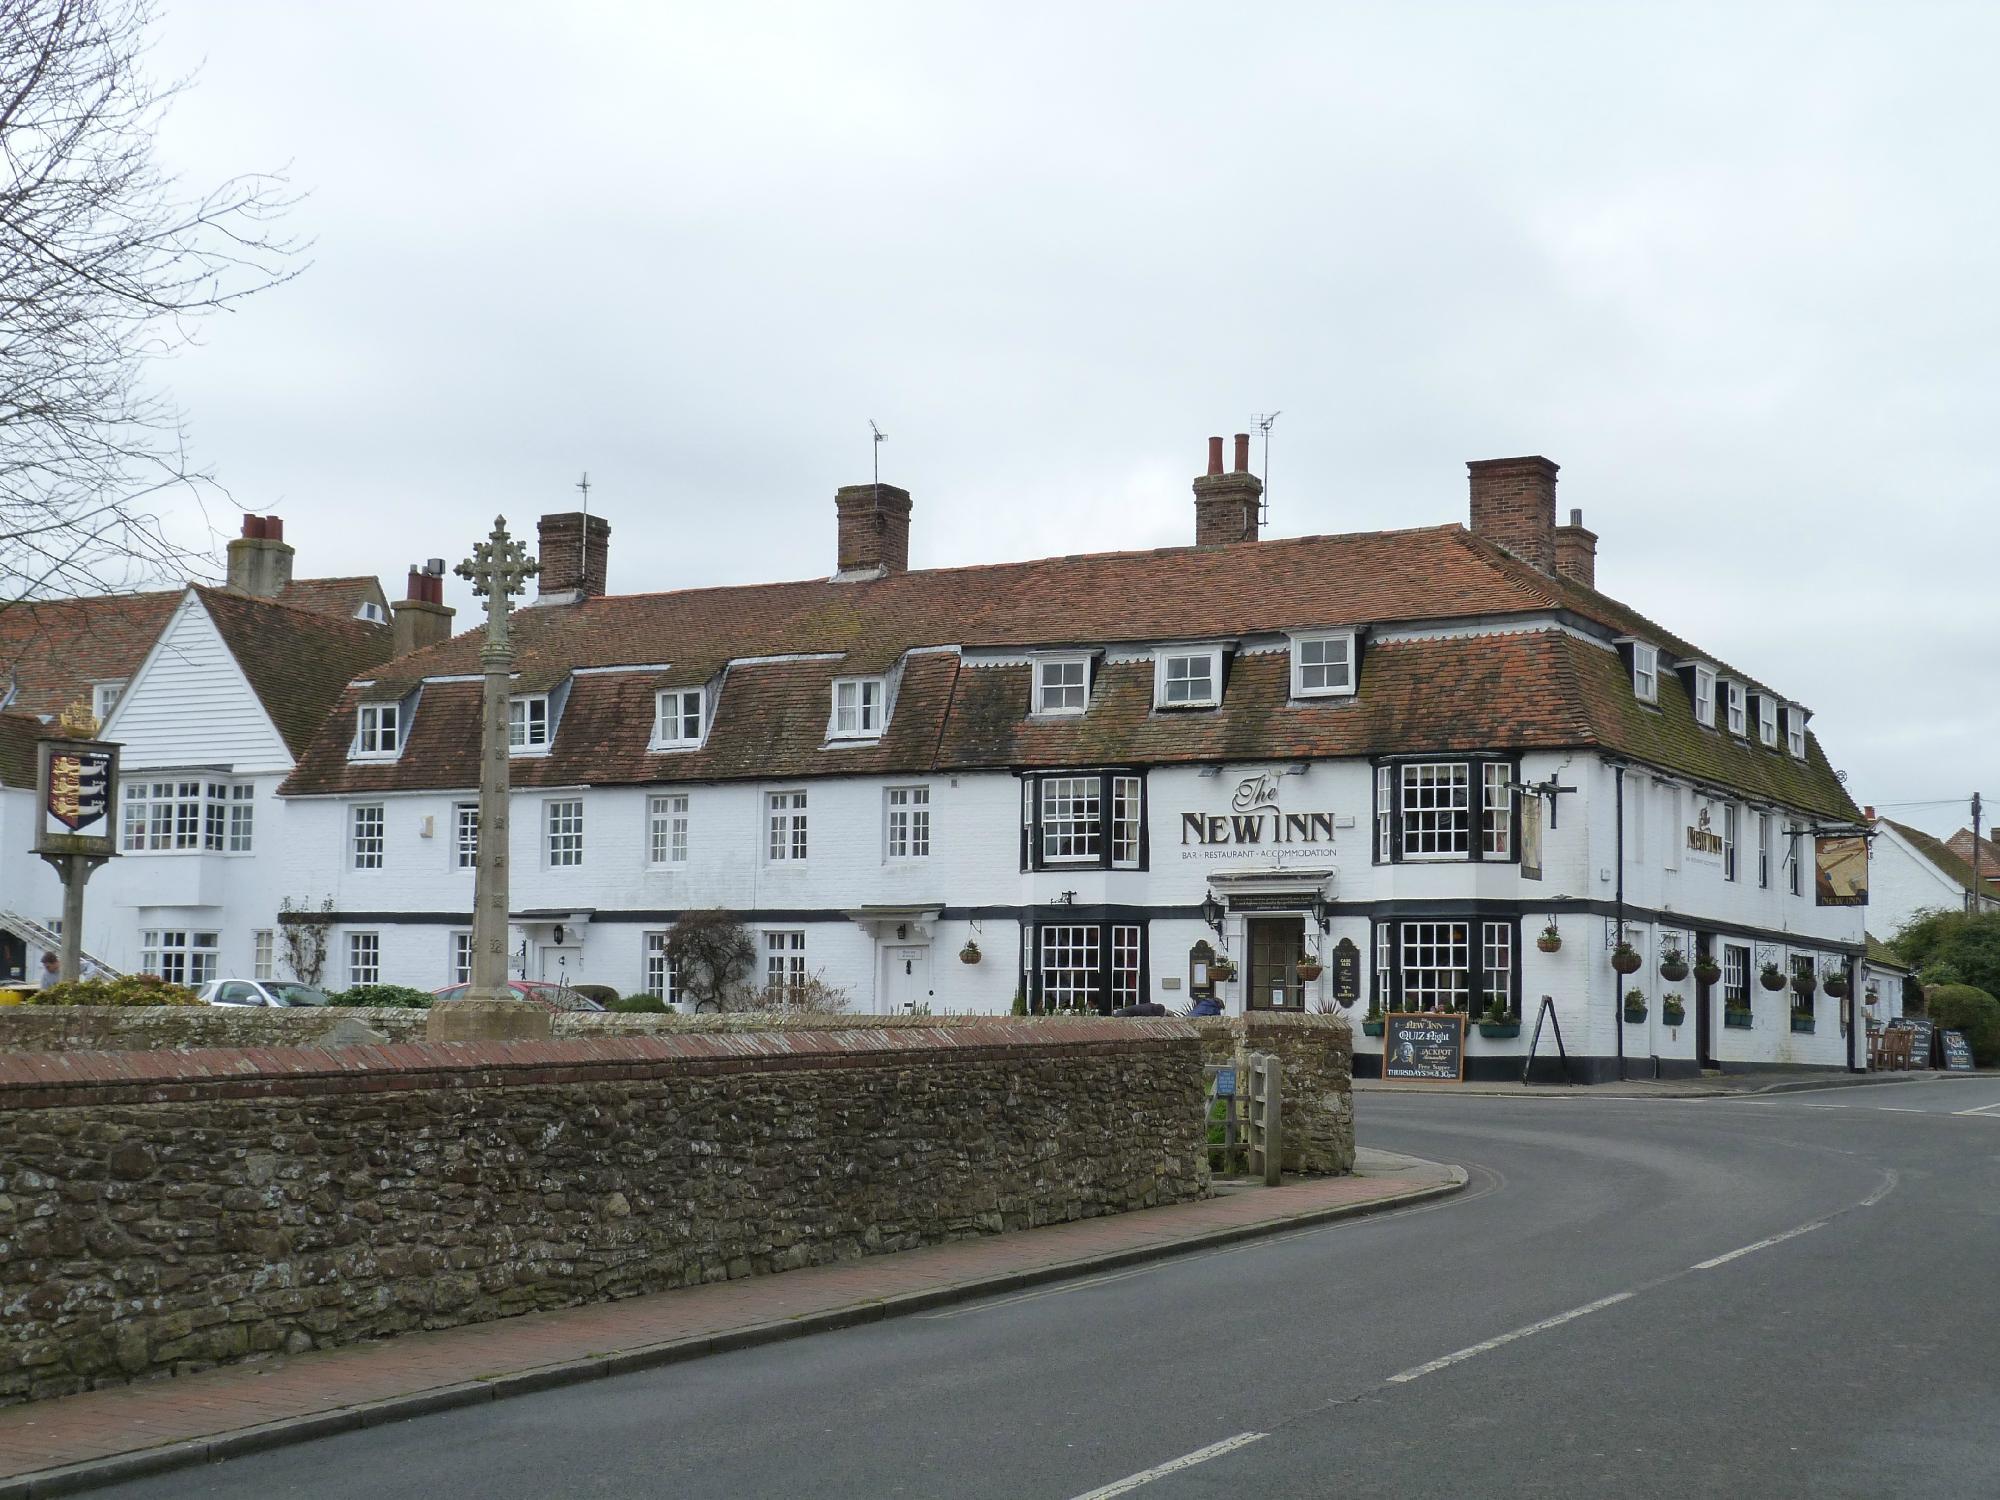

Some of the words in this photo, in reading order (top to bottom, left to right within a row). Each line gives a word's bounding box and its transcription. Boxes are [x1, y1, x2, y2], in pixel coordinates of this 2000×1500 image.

[1232, 773, 1281, 814] The
[1180, 812, 1265, 845] NEW
[1273, 812, 1336, 844] INN
[1182, 850, 1198, 860] BAR
[1204, 849, 1254, 860] RESTAURANT
[1260, 848, 1338, 859] ACCOMMODATION
[1399, 1030, 1425, 1040] QUIZ
